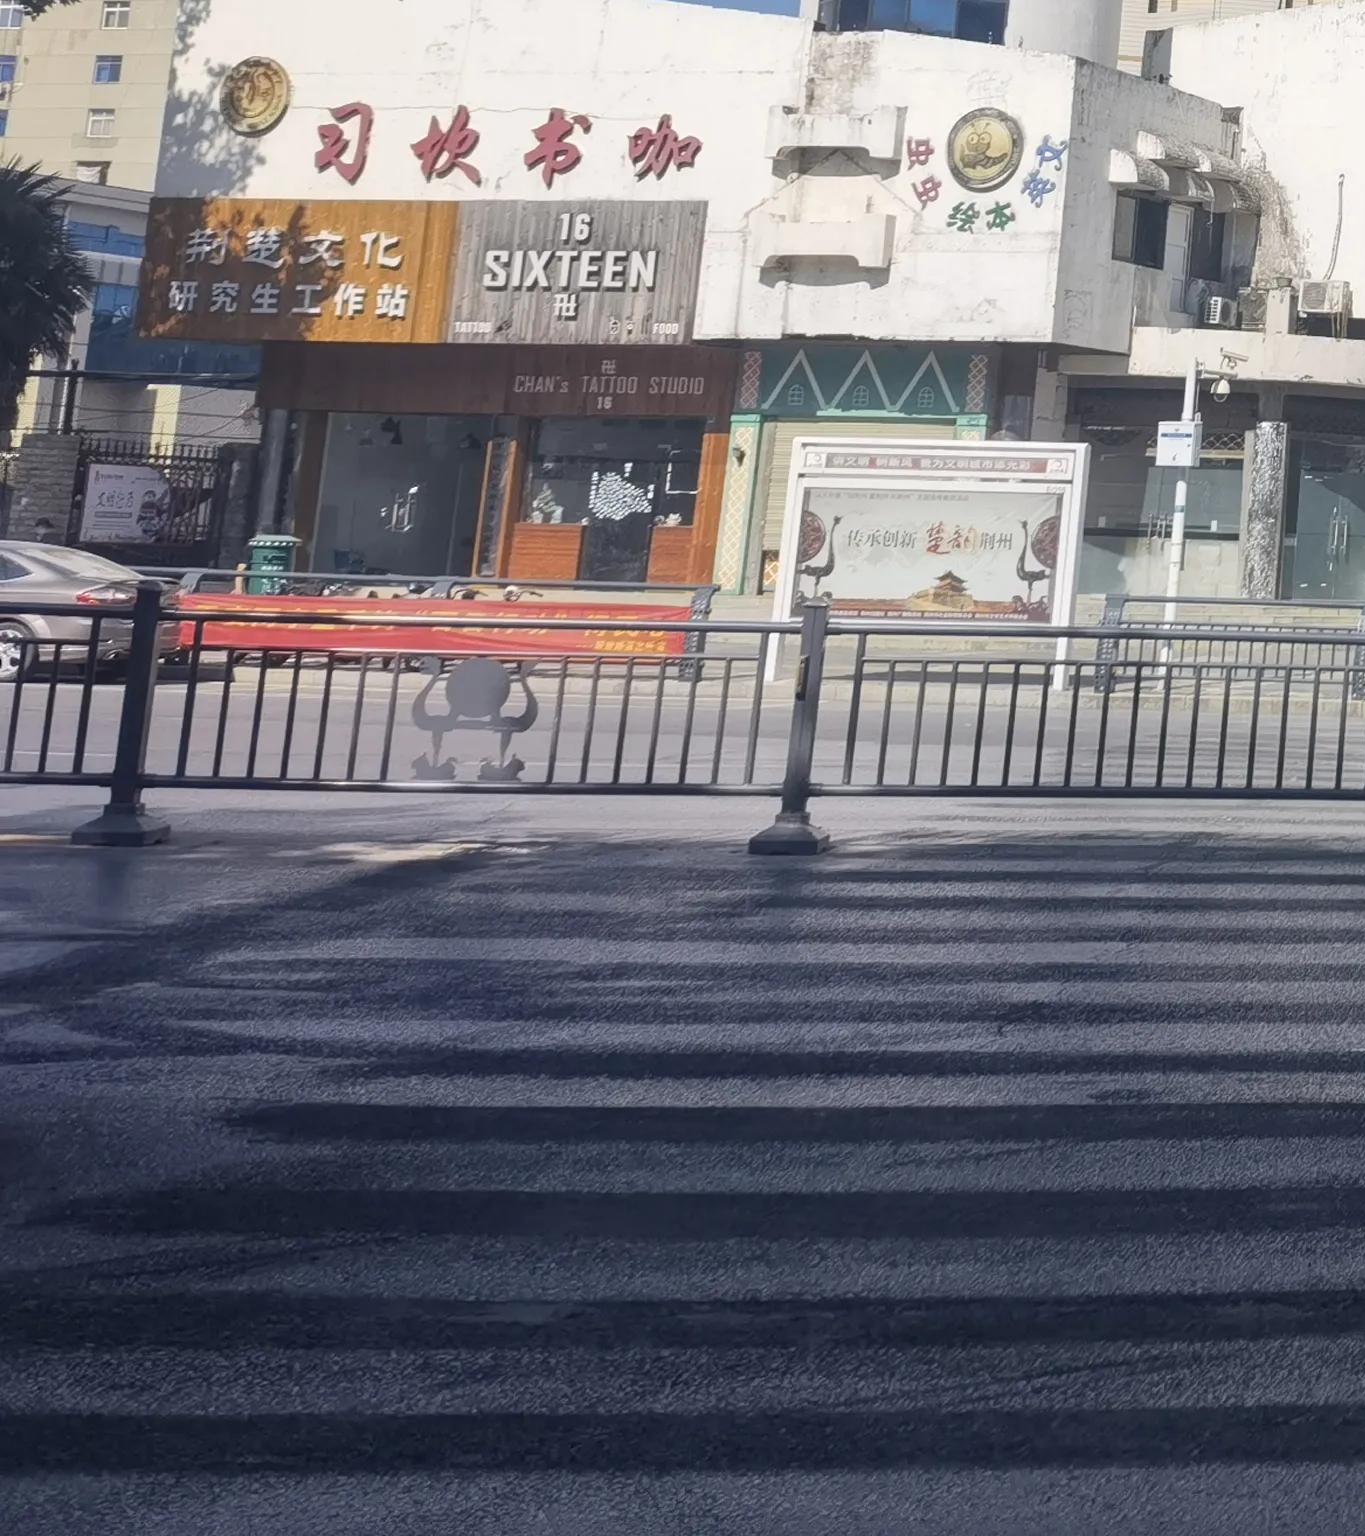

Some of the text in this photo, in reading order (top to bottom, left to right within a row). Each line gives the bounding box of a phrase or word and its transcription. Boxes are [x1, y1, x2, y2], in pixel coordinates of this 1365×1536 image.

[313, 101, 704, 188] 习坎书咖
[558, 213, 593, 243] 16
[184, 225, 404, 269] 荆楚文化
[482, 250, 658, 290] SIXTEEN
[167, 280, 409, 321] 研究生工作站
[513, 375, 705, 395] CHAN's TATTOO STUDIO
[596, 396, 613, 410] 16
[847, 527, 918, 549] 传承创新
